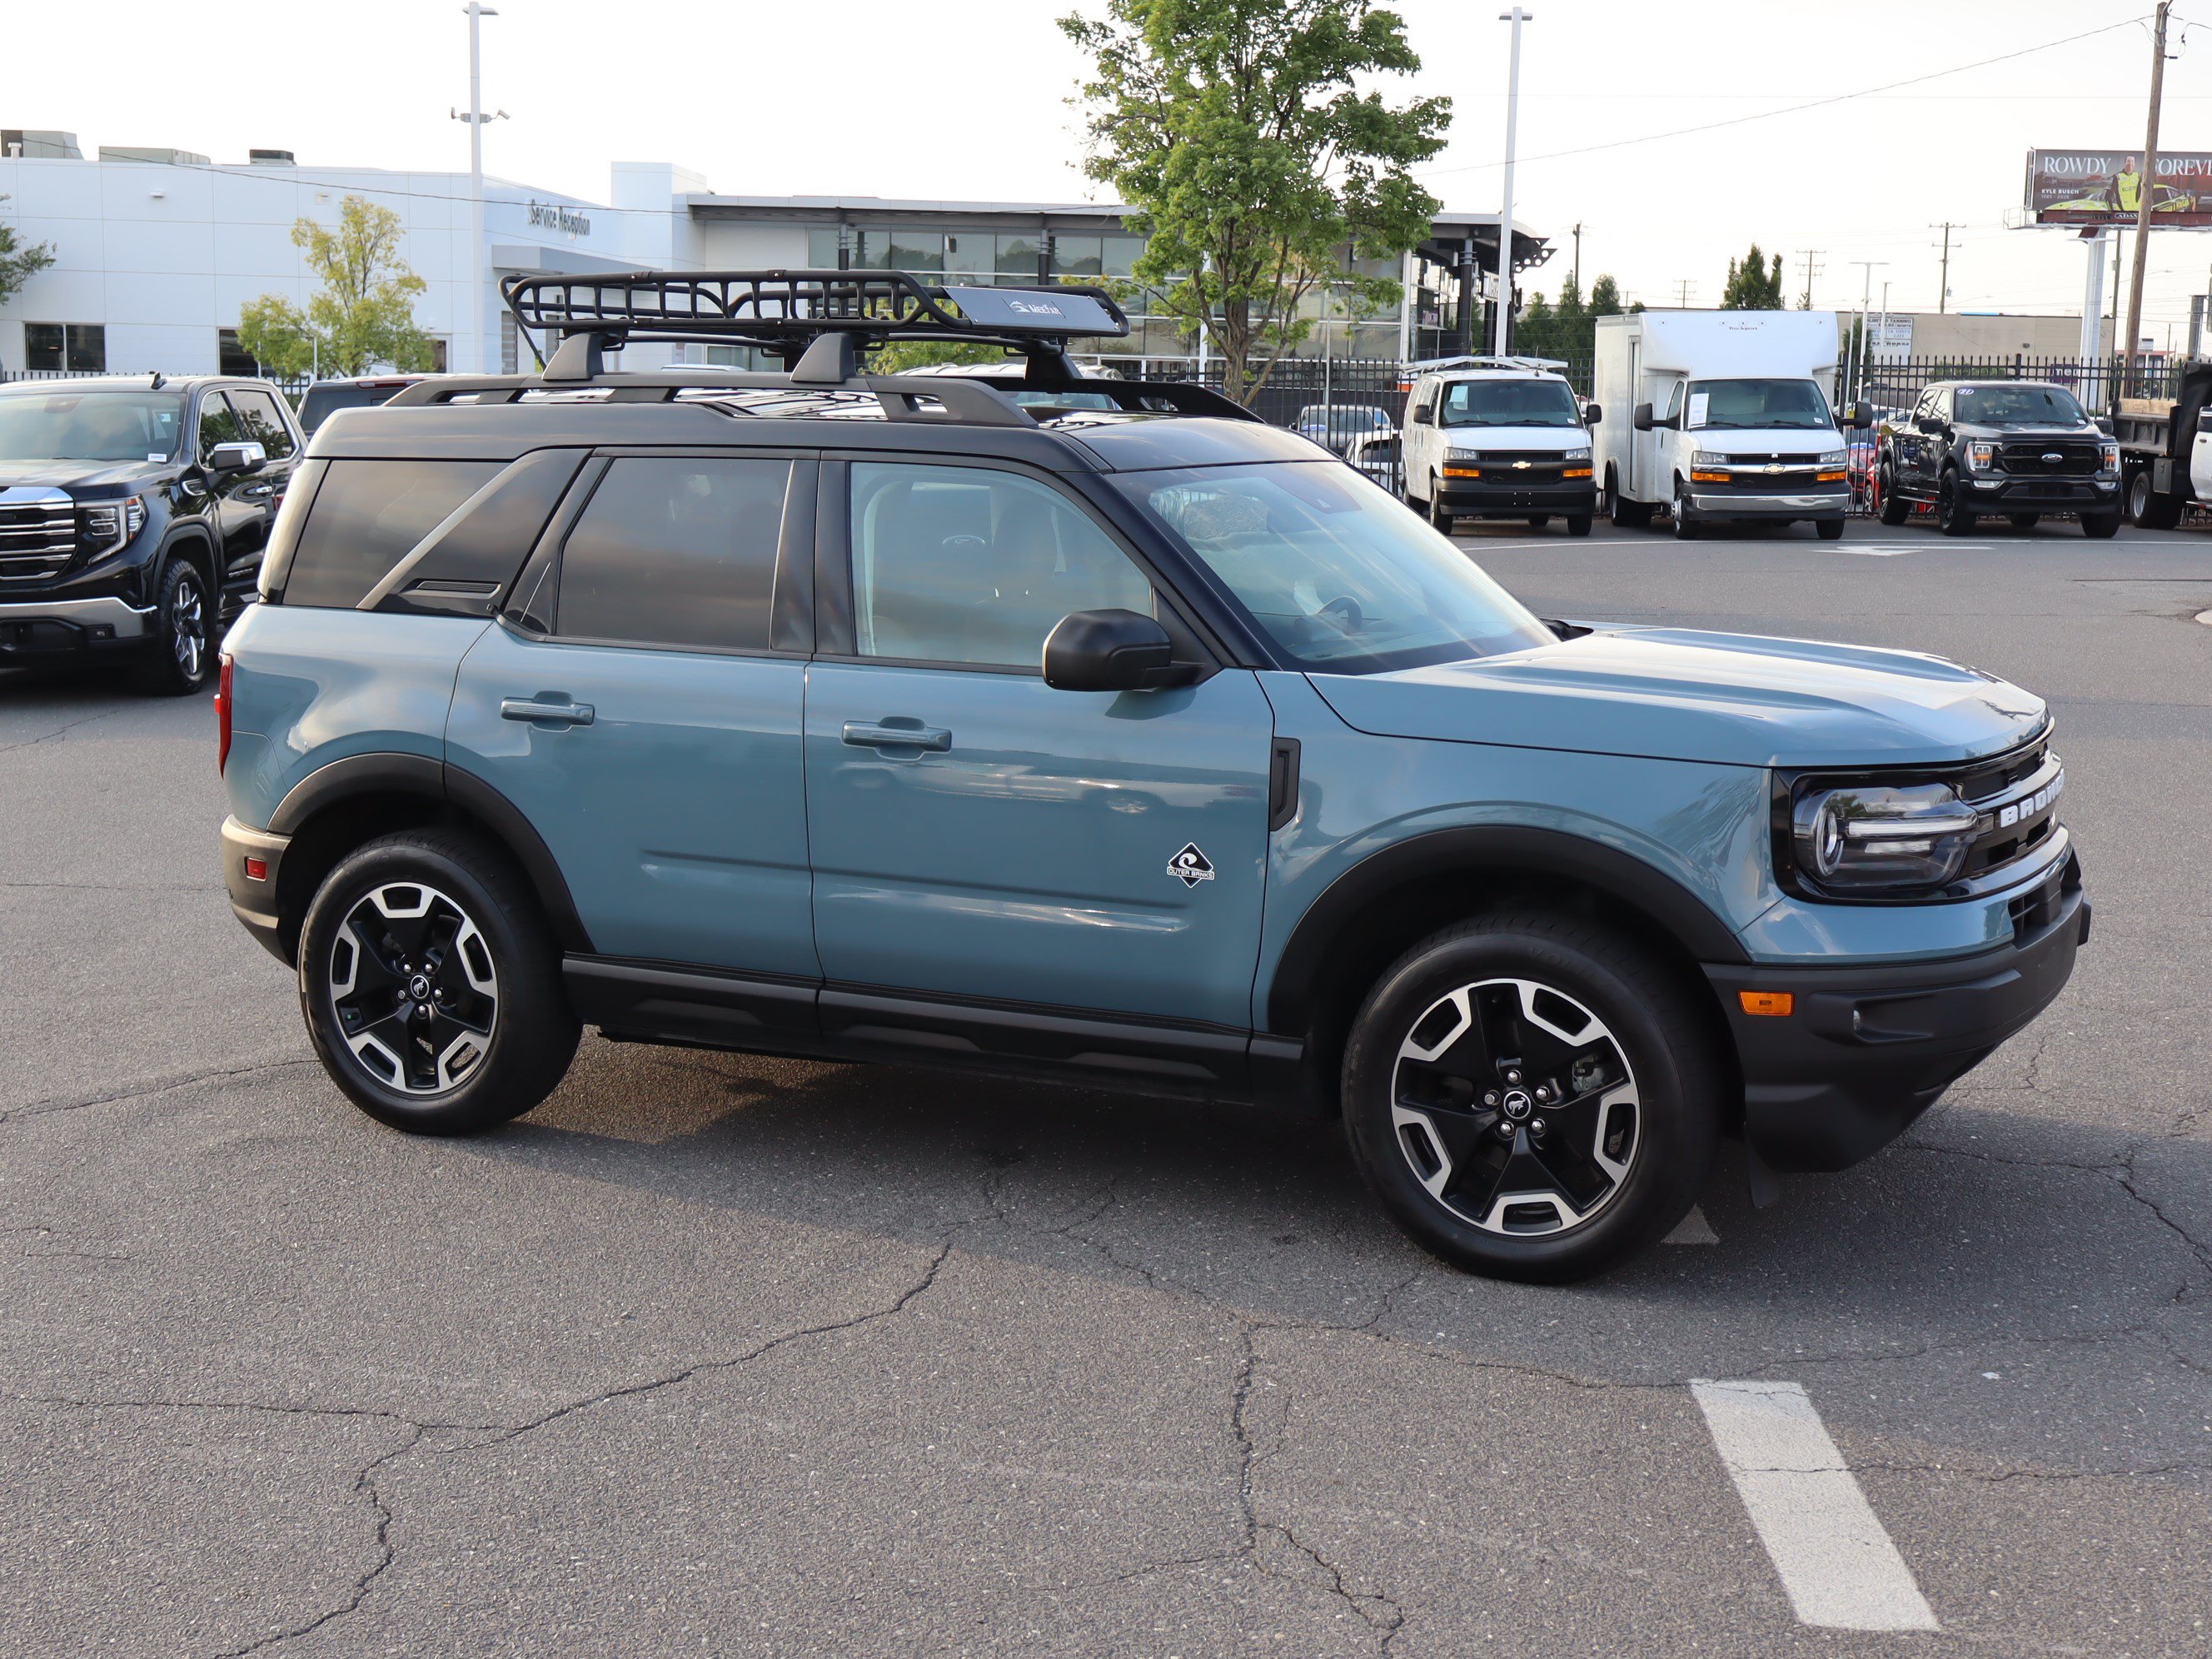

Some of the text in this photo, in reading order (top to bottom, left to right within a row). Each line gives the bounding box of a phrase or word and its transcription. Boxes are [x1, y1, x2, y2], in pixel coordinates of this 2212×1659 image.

[2044, 157, 2111, 174] ROWDY
[531, 198, 590, 238] Service Reception
